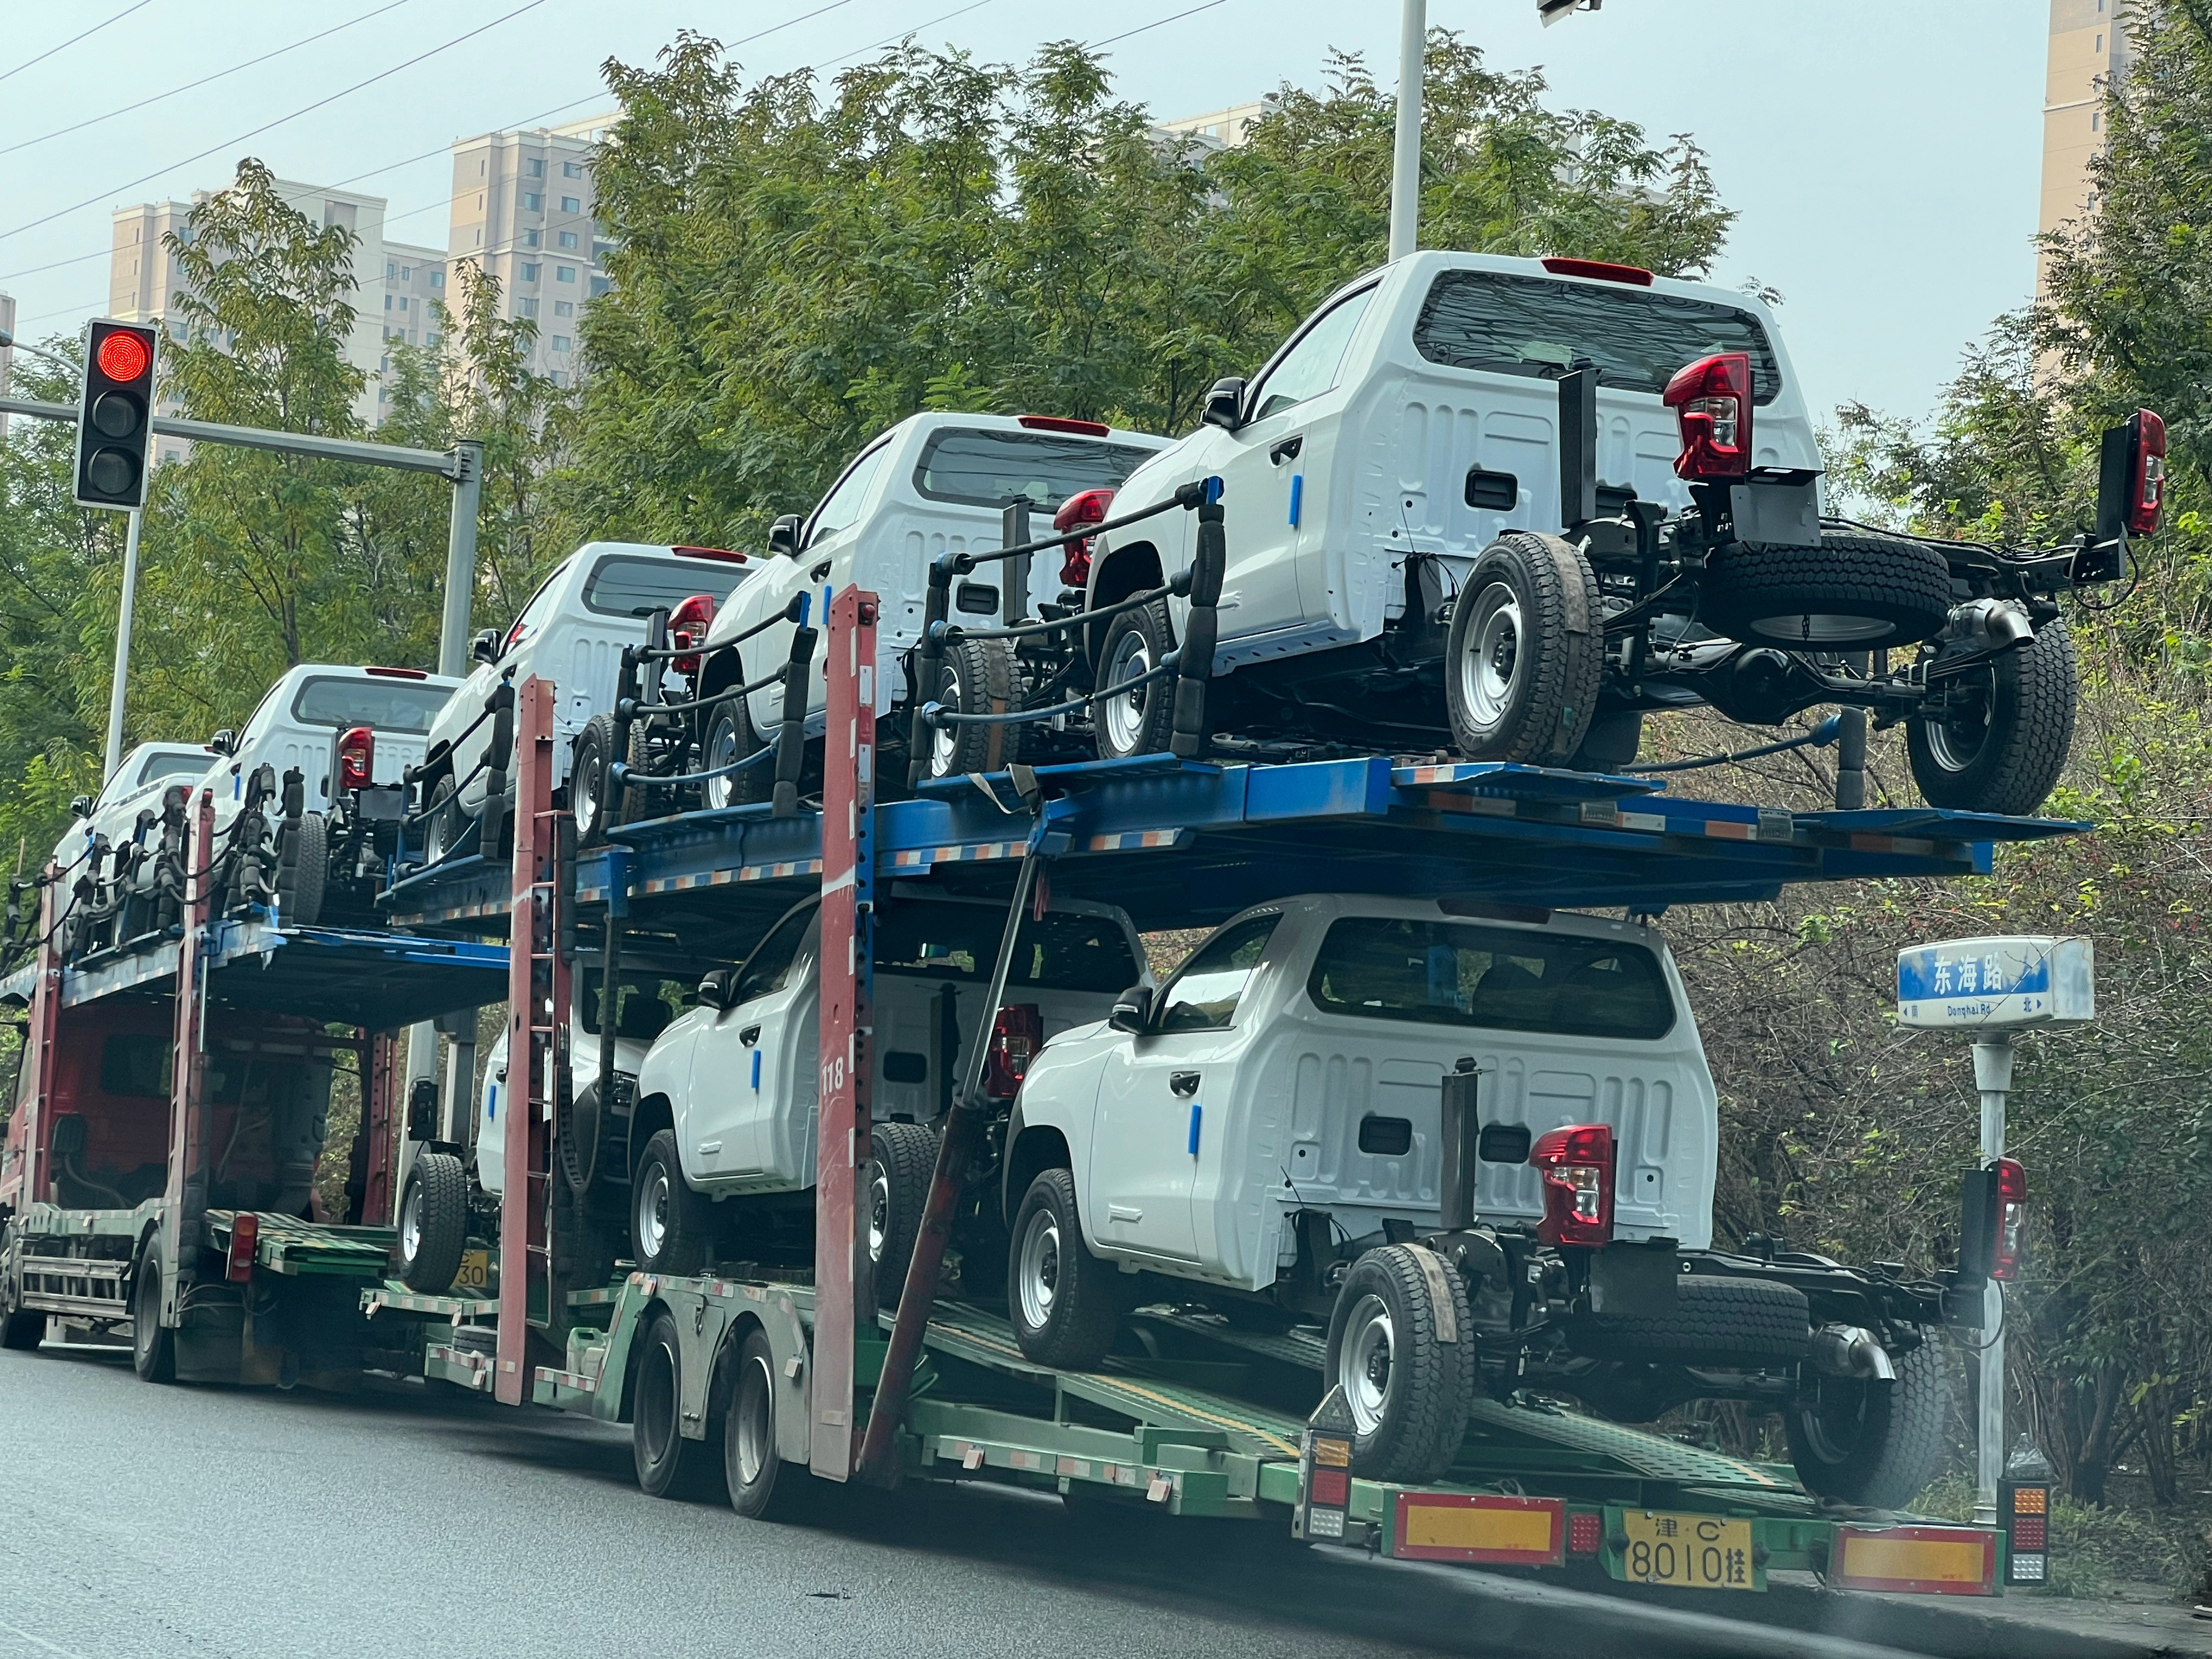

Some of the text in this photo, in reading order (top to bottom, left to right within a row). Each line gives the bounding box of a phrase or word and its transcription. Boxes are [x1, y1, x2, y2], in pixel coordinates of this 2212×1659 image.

[1934, 952, 2002, 995] 东海路
[1947, 1005, 1978, 1019] Donghai
[2023, 997, 2032, 1013] 北
[822, 1057, 843, 1096] 118
